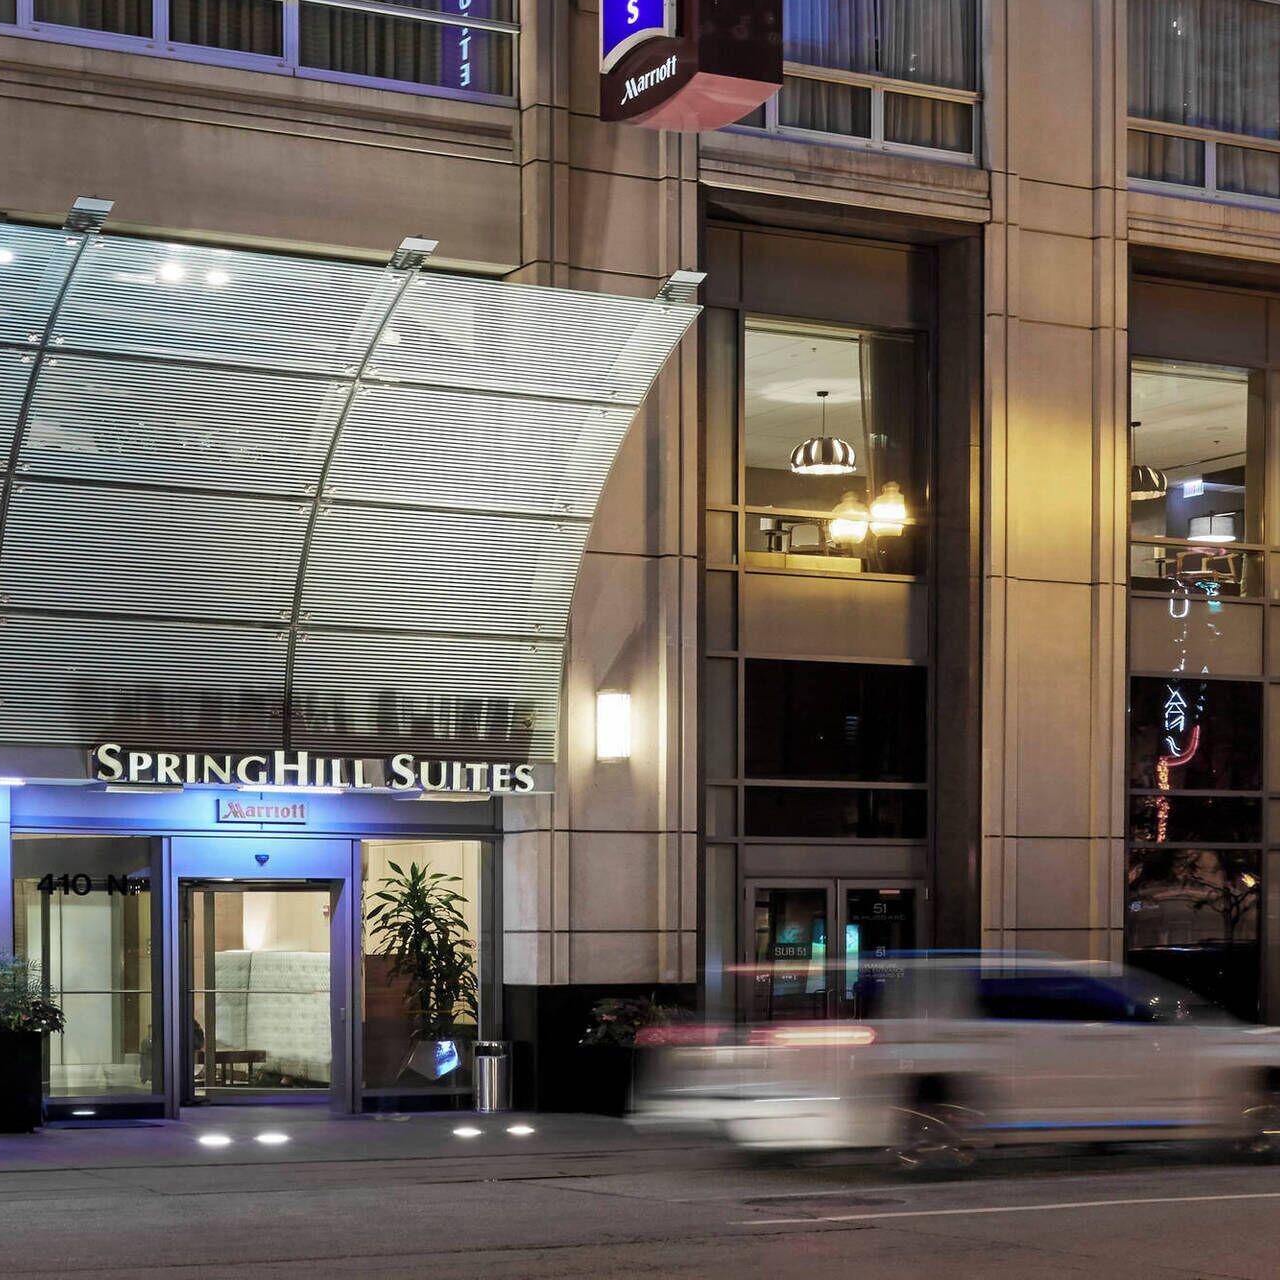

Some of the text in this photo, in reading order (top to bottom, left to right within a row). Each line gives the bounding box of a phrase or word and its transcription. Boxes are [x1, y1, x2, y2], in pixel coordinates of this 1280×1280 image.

[620, 55, 678, 104] Marriott
[94, 742, 536, 793] SPRINGHILL SUITES
[222, 800, 307, 822] Marriott
[36, 873, 92, 896] 410
[774, 947, 807, 956] SUB 51
